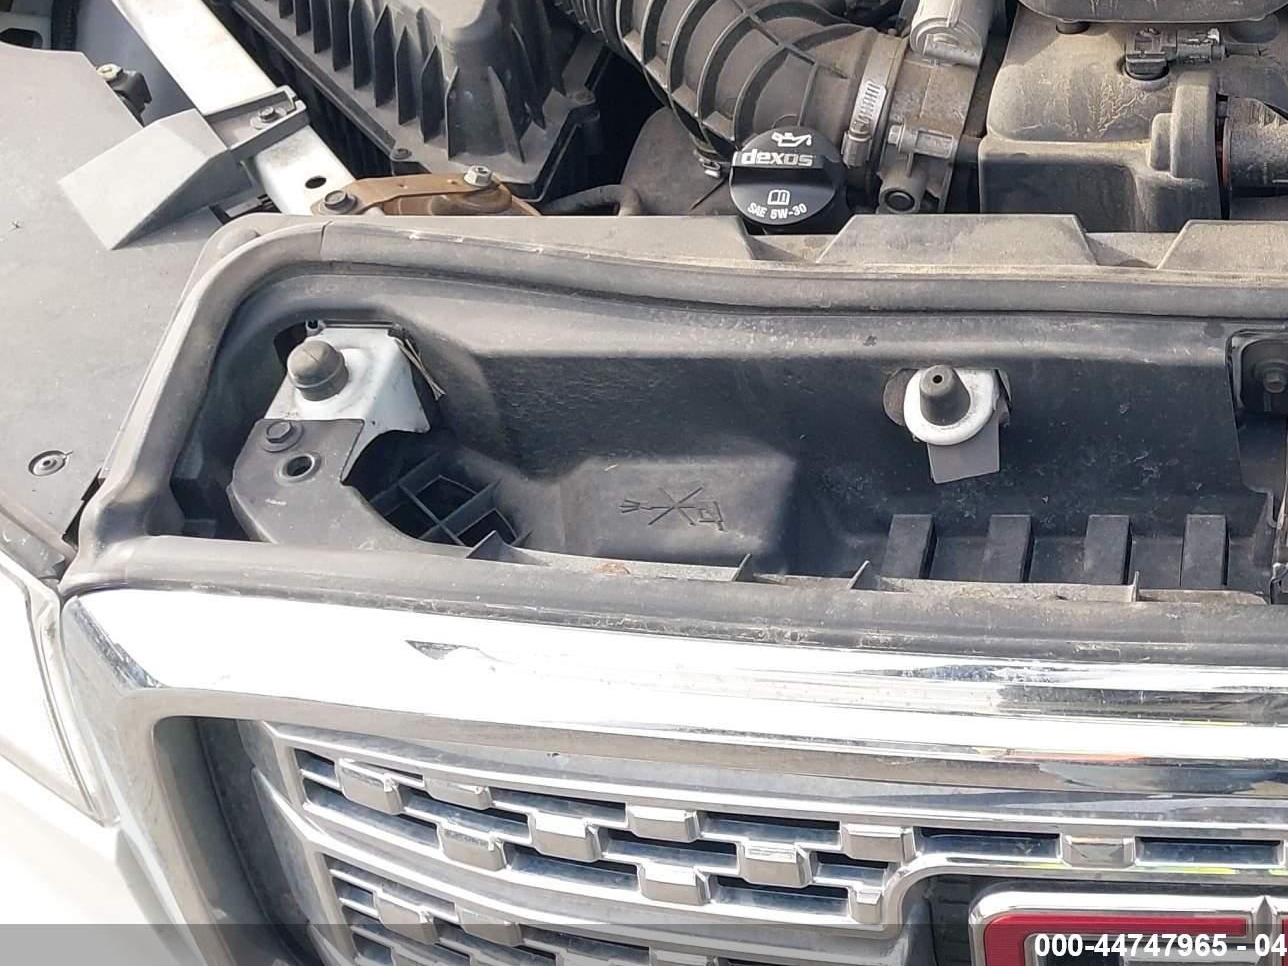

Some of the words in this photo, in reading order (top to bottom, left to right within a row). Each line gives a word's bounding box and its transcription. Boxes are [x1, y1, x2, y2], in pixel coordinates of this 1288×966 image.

[740, 148, 814, 167] dexos
[746, 202, 768, 218] SAE
[769, 202, 808, 220] 5W-30
